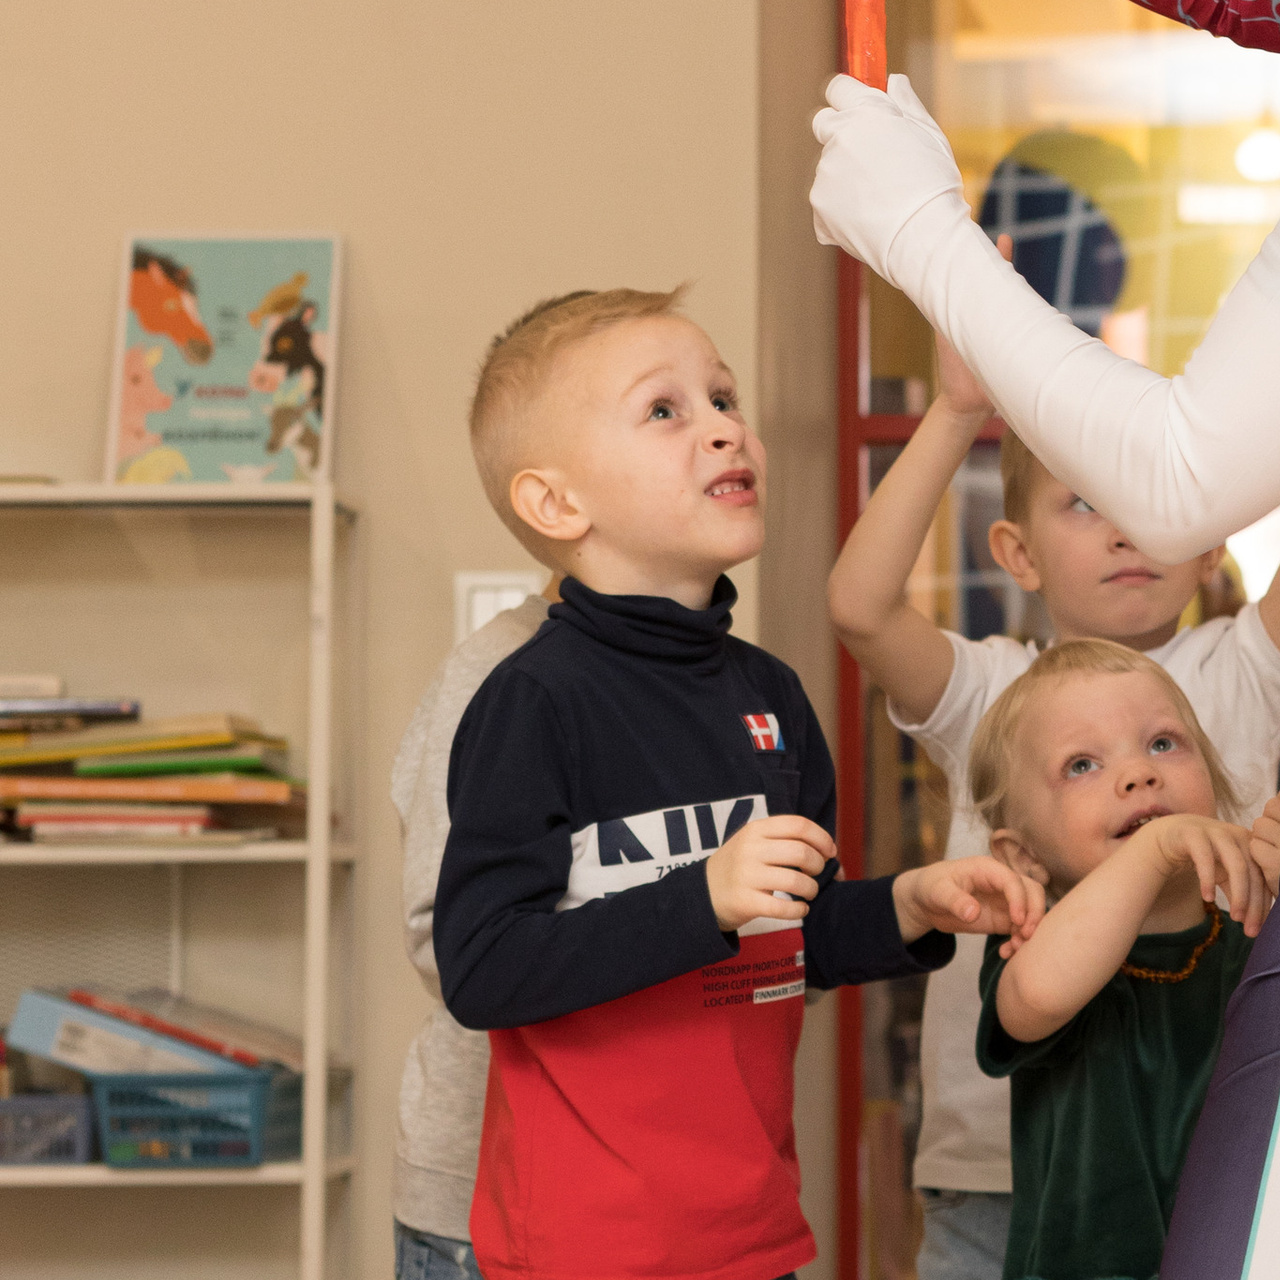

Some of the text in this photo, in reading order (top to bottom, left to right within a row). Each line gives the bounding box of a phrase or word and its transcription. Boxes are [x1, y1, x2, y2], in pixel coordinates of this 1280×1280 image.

[702, 964, 751, 978] NORDKAPP
[703, 980, 729, 992] HIGH
[730, 978, 752, 990] CLIFF
[704, 993, 745, 1008] LOCATED
[755, 987, 788, 1000] FINNMARK
